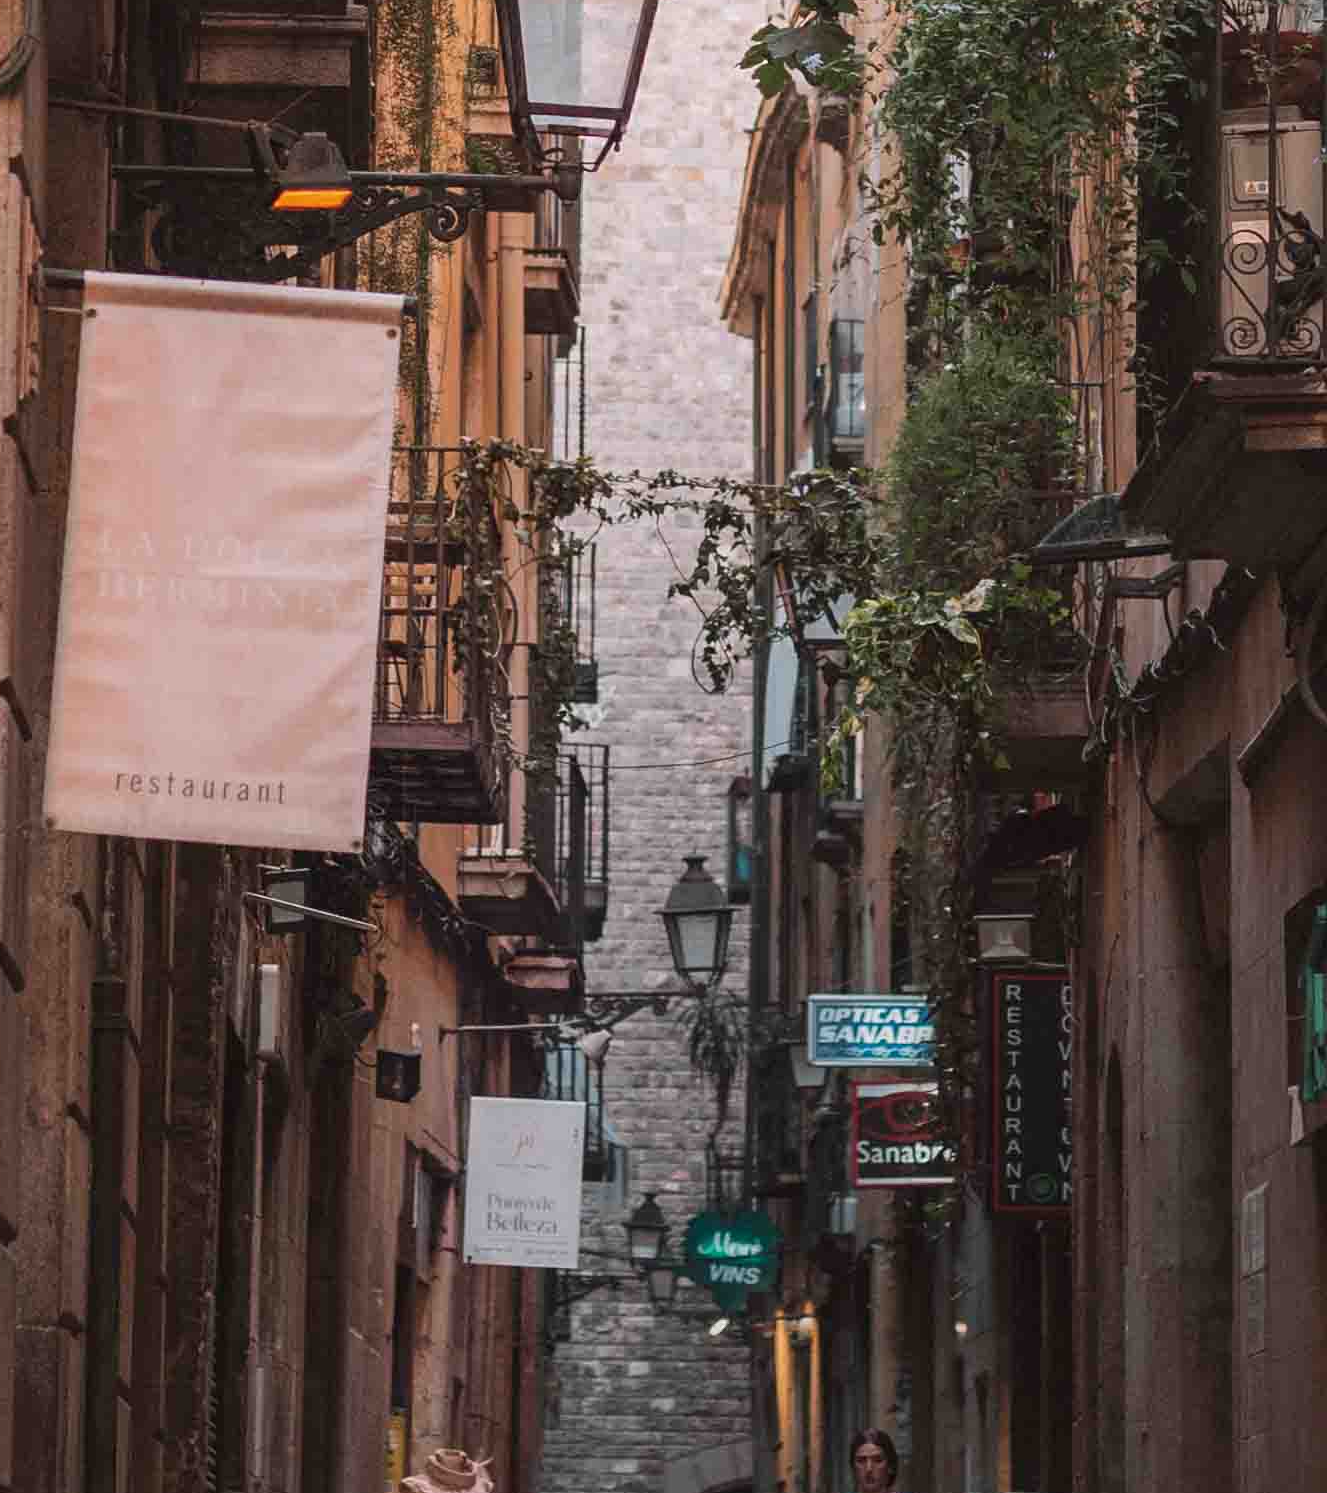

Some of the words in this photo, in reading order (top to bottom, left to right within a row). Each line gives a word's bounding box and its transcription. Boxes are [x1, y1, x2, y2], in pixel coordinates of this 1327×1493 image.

[113, 771, 288, 805] restaurant
[818, 1007, 921, 1024] OPTICAS
[1004, 983, 1023, 1203] RESTAURANT
[709, 1263, 762, 1285] VINS
